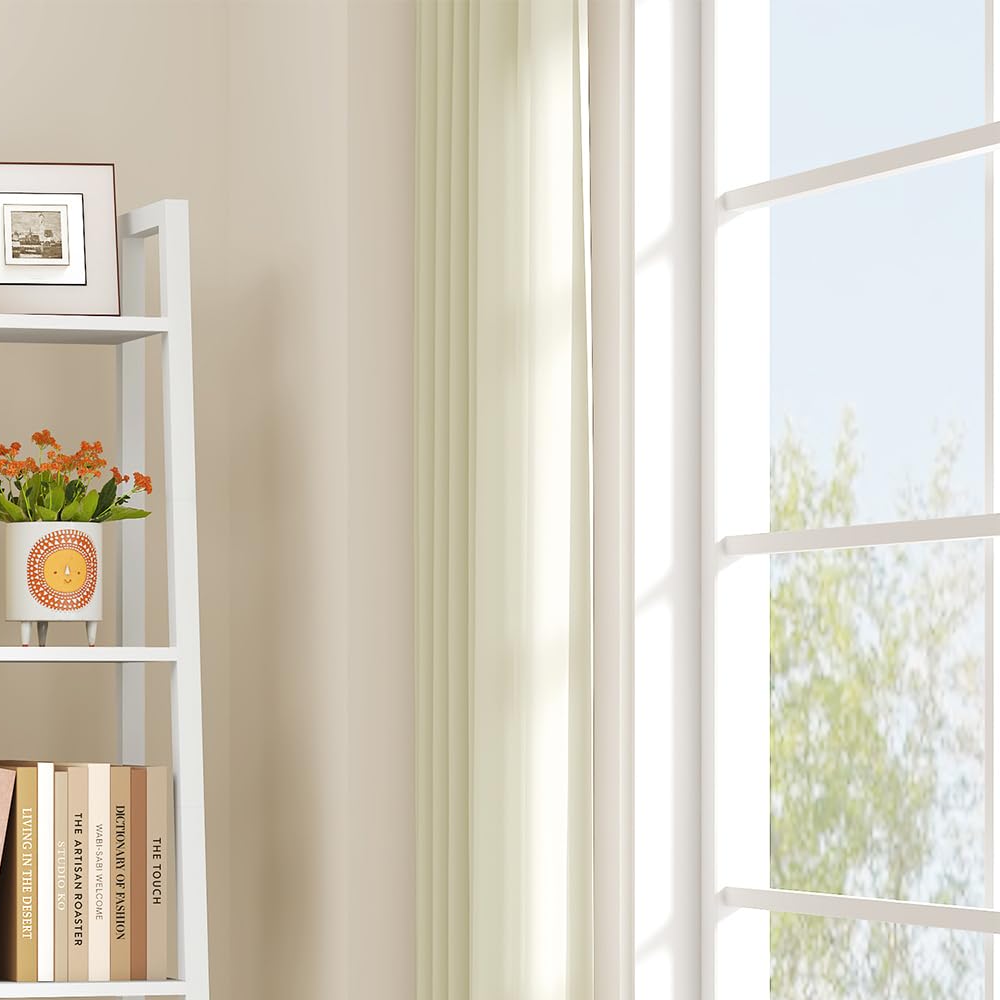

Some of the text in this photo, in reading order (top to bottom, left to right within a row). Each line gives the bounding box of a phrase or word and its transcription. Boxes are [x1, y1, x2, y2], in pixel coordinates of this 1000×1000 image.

[22, 808, 32, 940] LIVING IN THE DESERT
[57, 841, 65, 911] STUDIO KO
[74, 813, 83, 946] THE ARTISAN ROASTER
[96, 824, 104, 920] WABI-SABI WELCOME
[115, 805, 126, 940] DICTIONARY OF FASHION
[152, 837, 161, 905] THE TOUCH
